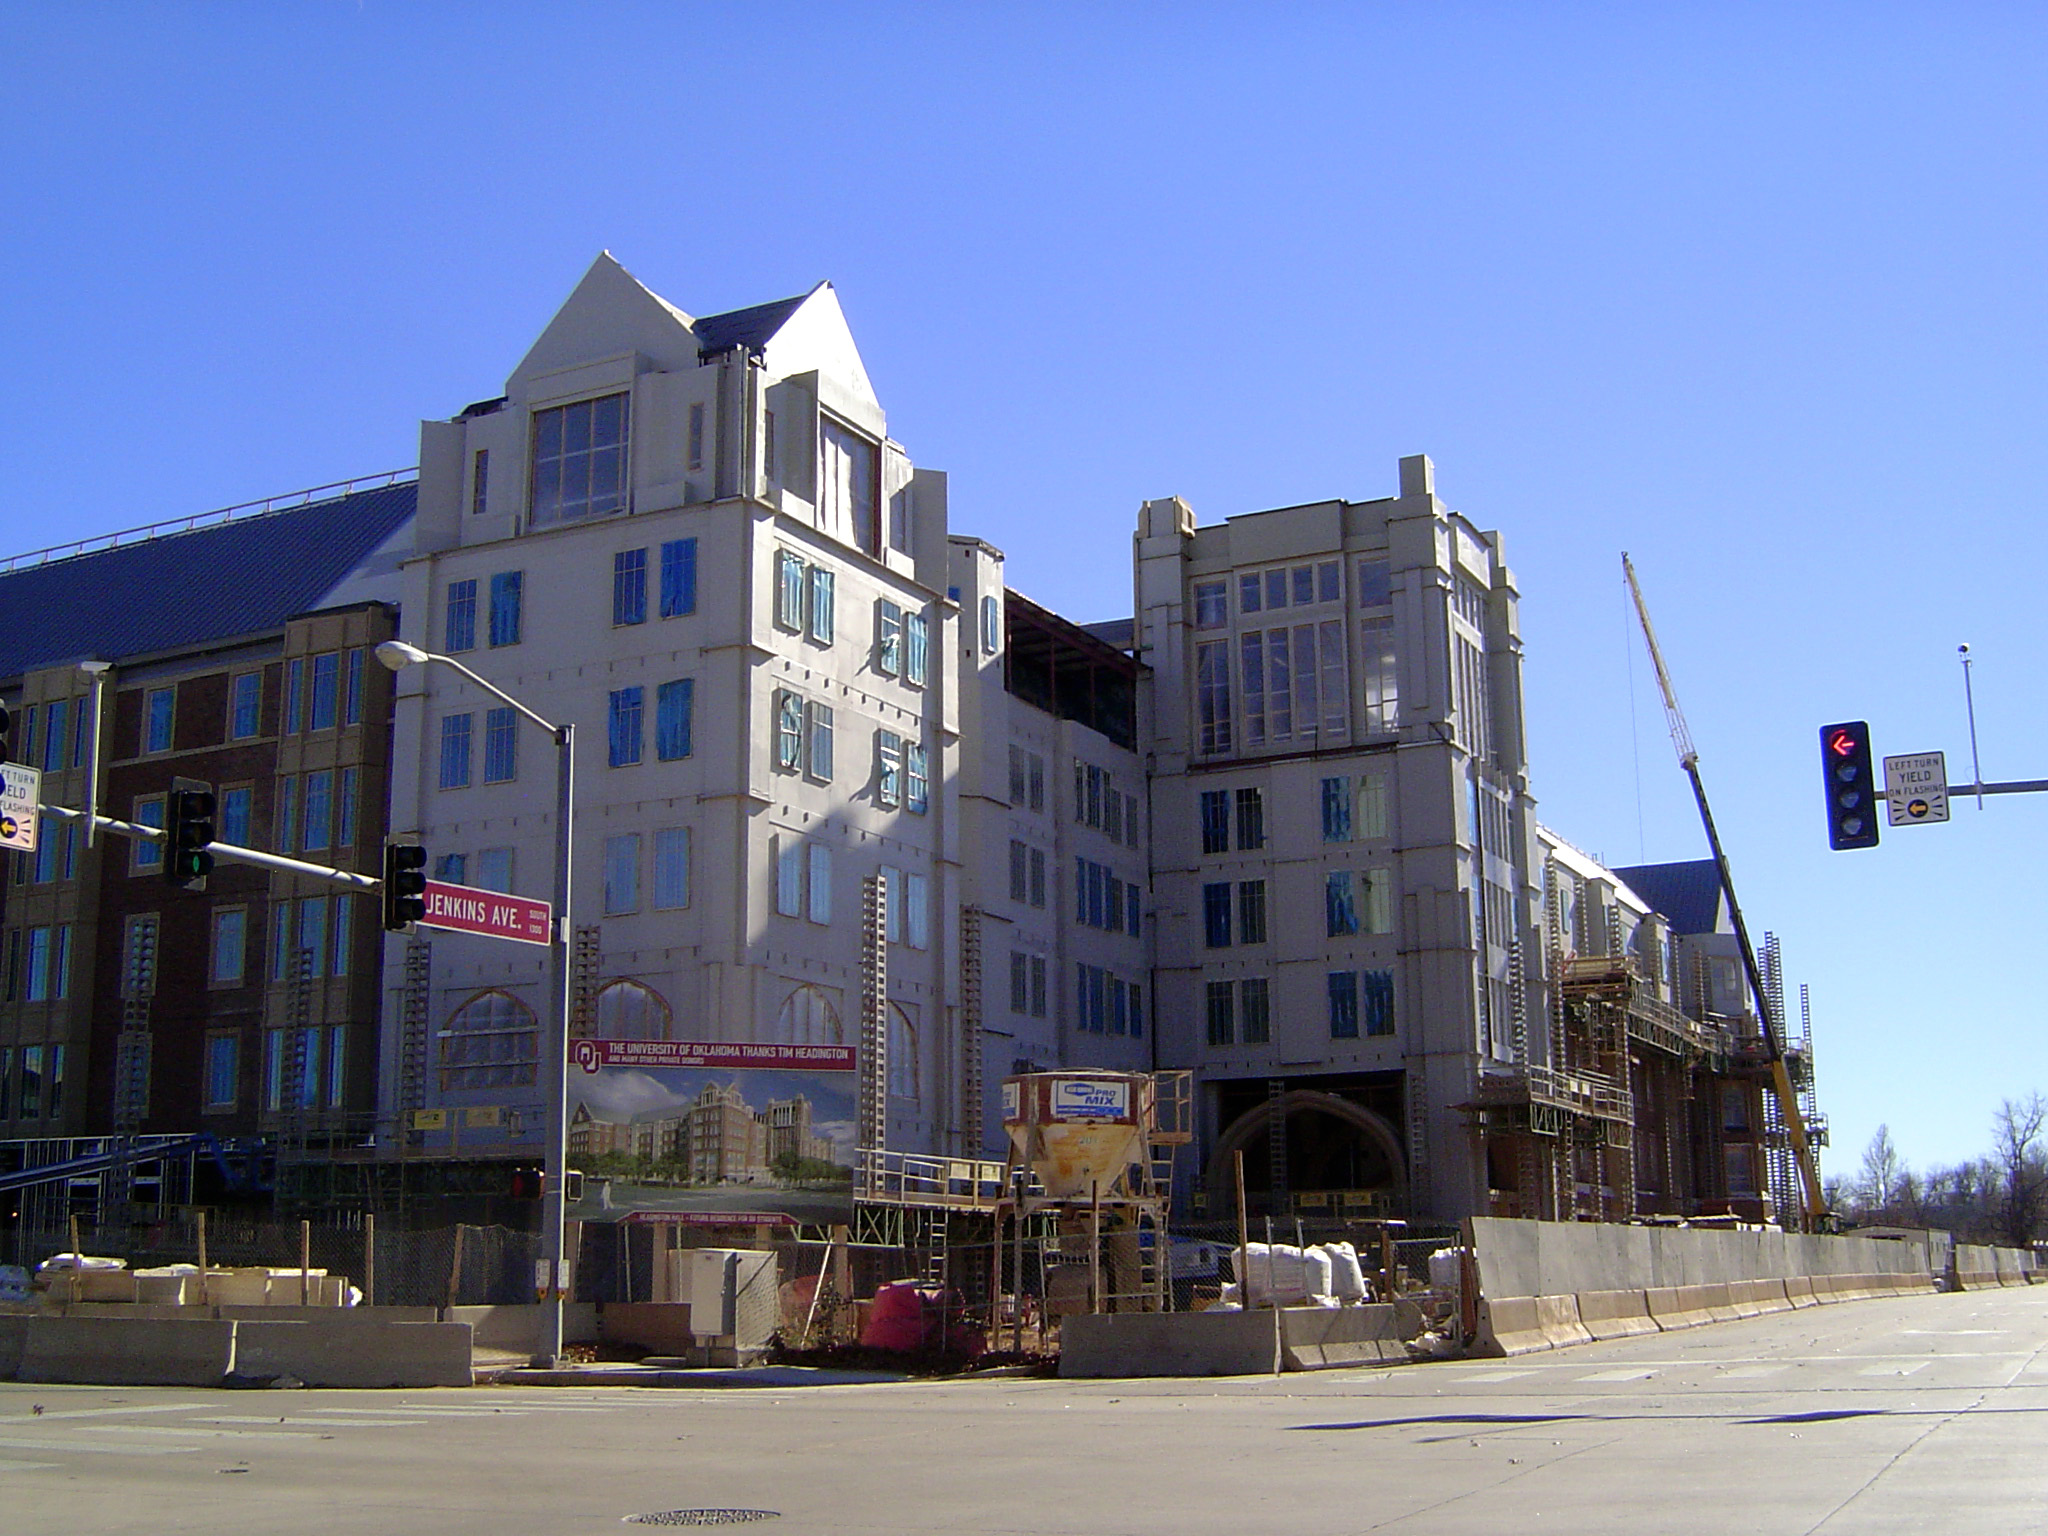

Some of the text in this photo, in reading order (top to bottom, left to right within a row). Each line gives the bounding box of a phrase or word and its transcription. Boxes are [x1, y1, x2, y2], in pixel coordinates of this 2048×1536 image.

[1889, 758, 1939, 771] LEFT TURN
[13, 771, 35, 785] TURN
[1899, 770, 1931, 783] YIELD
[4, 784, 26, 799] IELD
[1889, 784, 1944, 797] ON FLASHING
[425, 893, 522, 929] JENKINS AVE.
[529, 909, 547, 921] SOUTH
[609, 1043, 849, 1060] THE UNIVERSITY OF OKLAHOMA THANKS TIM HEADINGTON
[1095, 1089, 1116, 1097] PRO
[1085, 1096, 1115, 1105] MIX
